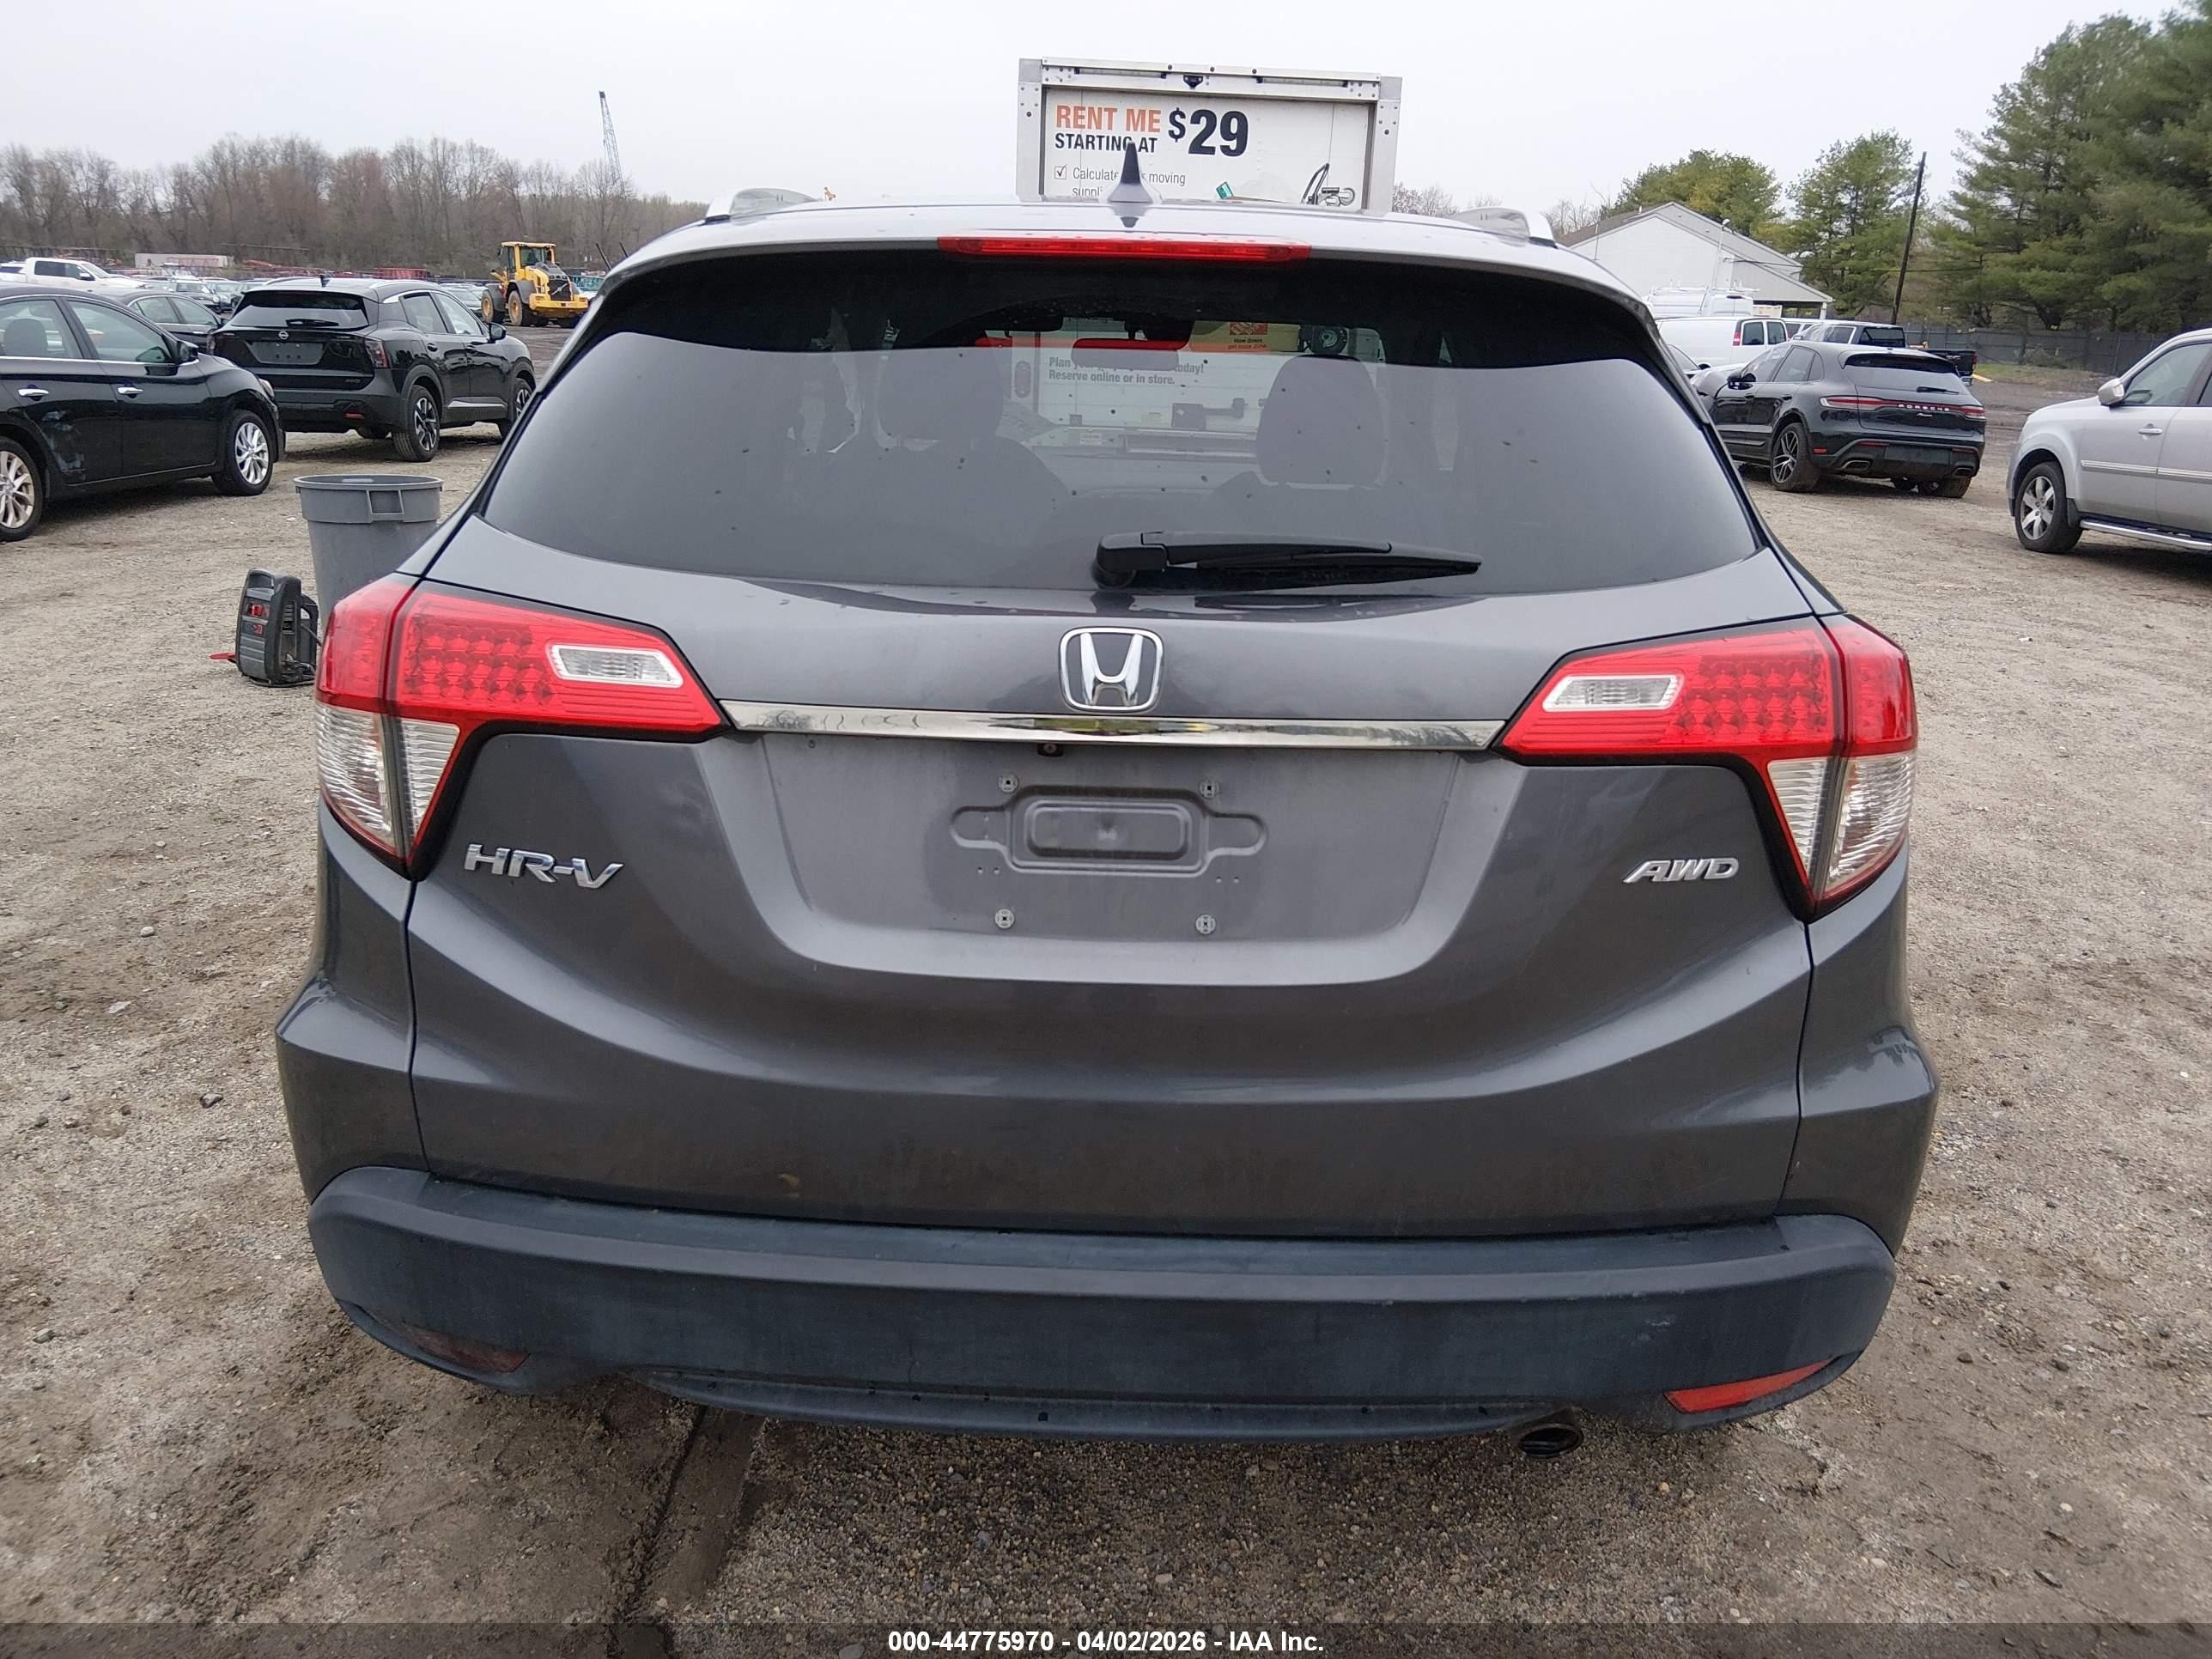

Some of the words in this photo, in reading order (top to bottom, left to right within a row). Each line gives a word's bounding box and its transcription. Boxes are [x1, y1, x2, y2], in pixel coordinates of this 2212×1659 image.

[1056, 105, 1117, 131] RENT
[1126, 108, 1161, 132] ME
[1054, 133, 1133, 152] STARTING
[1138, 137, 1158, 153] AT
[1168, 107, 1249, 156] $29
[1149, 173, 1186, 186] moving
[1048, 356, 1071, 368] Plan
[1048, 369, 1088, 380] Reserve
[1091, 372, 1121, 383] online
[1123, 374, 1133, 383] or
[1148, 374, 1176, 385] store.
[464, 844, 624, 889] HR-V
[1622, 857, 1740, 884] AWD
